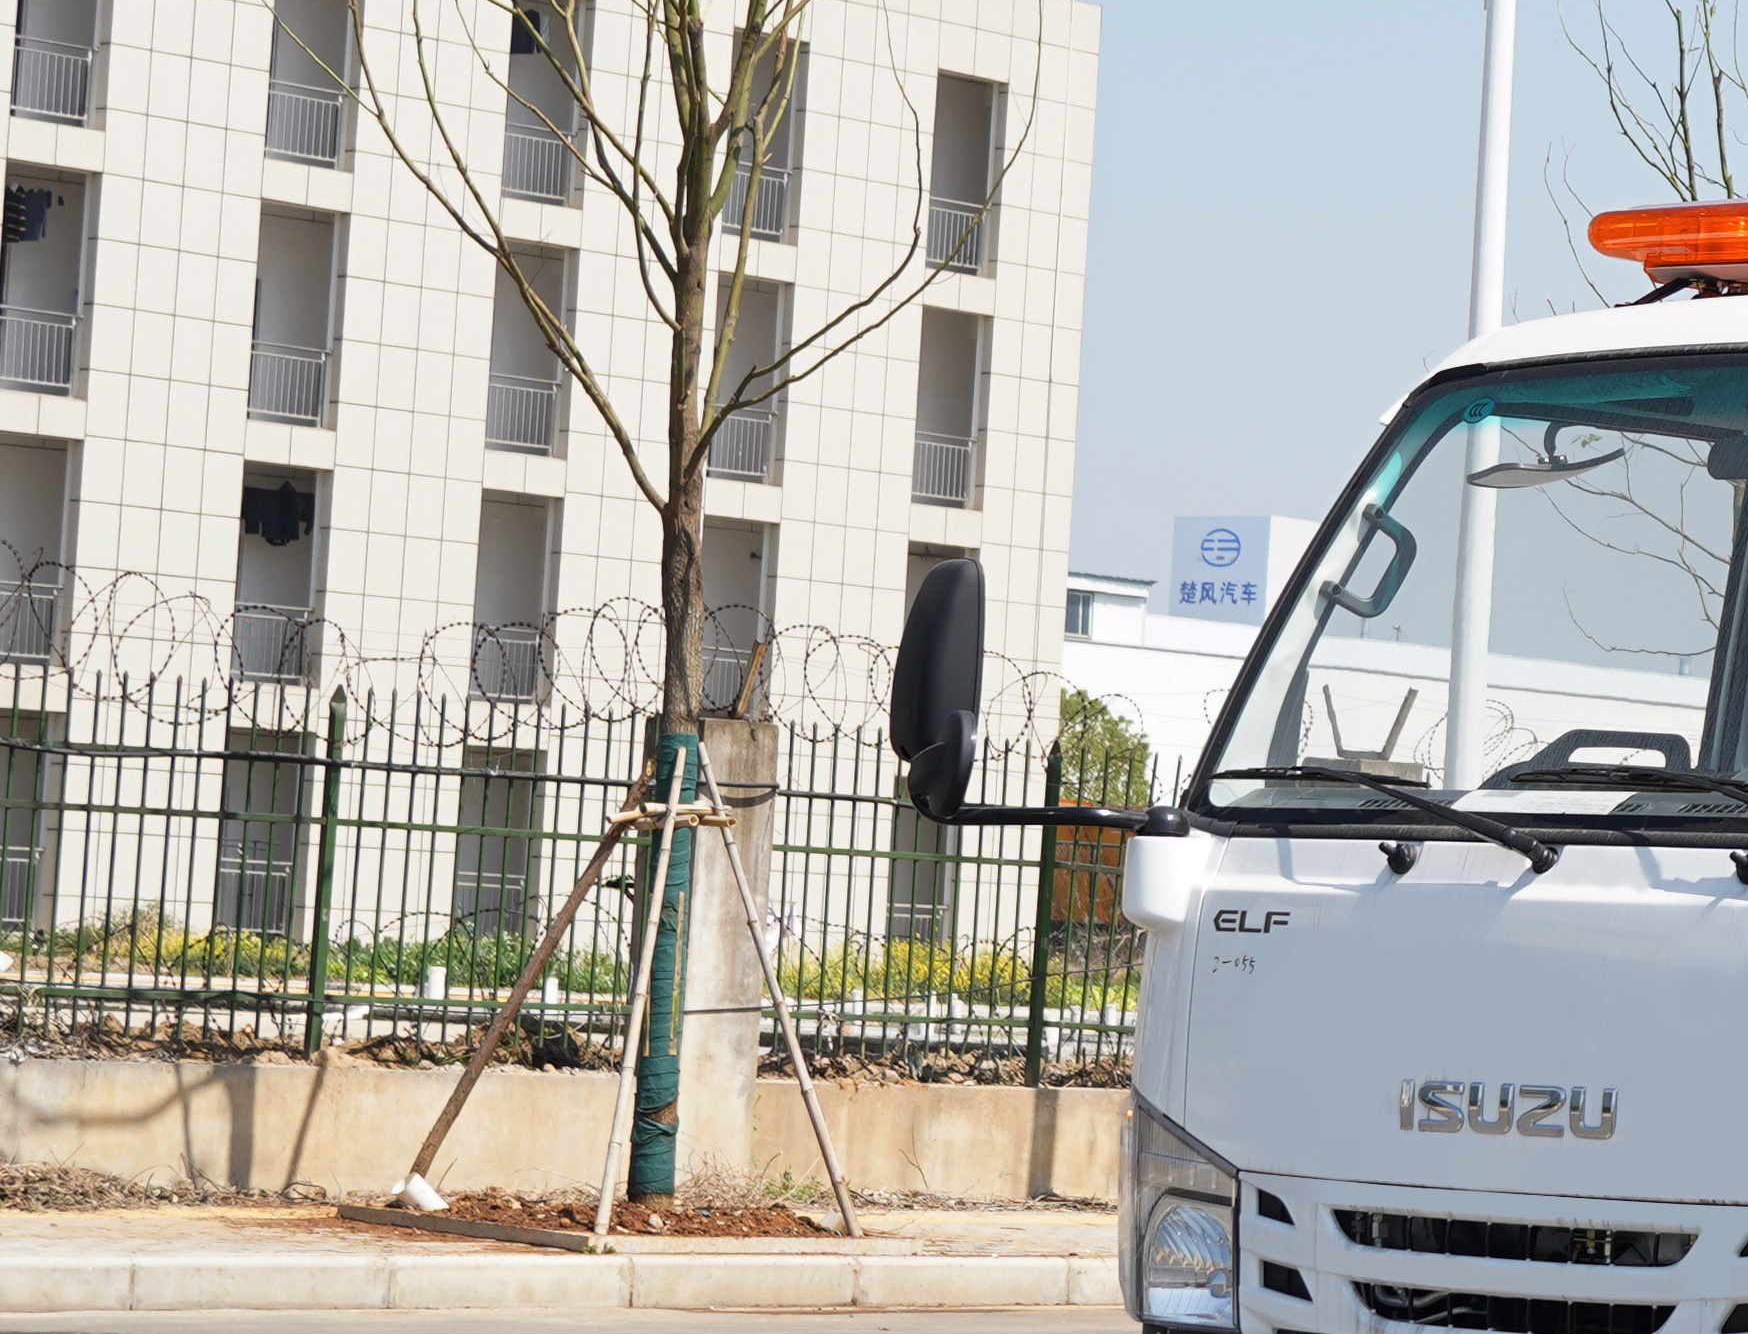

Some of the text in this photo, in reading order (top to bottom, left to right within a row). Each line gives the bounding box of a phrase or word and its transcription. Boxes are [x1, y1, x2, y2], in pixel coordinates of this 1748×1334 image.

[1180, 580, 1258, 605] 楚风汽车
[1213, 910, 1291, 933] ELF
[1399, 1079, 1618, 1139] ISUZU
